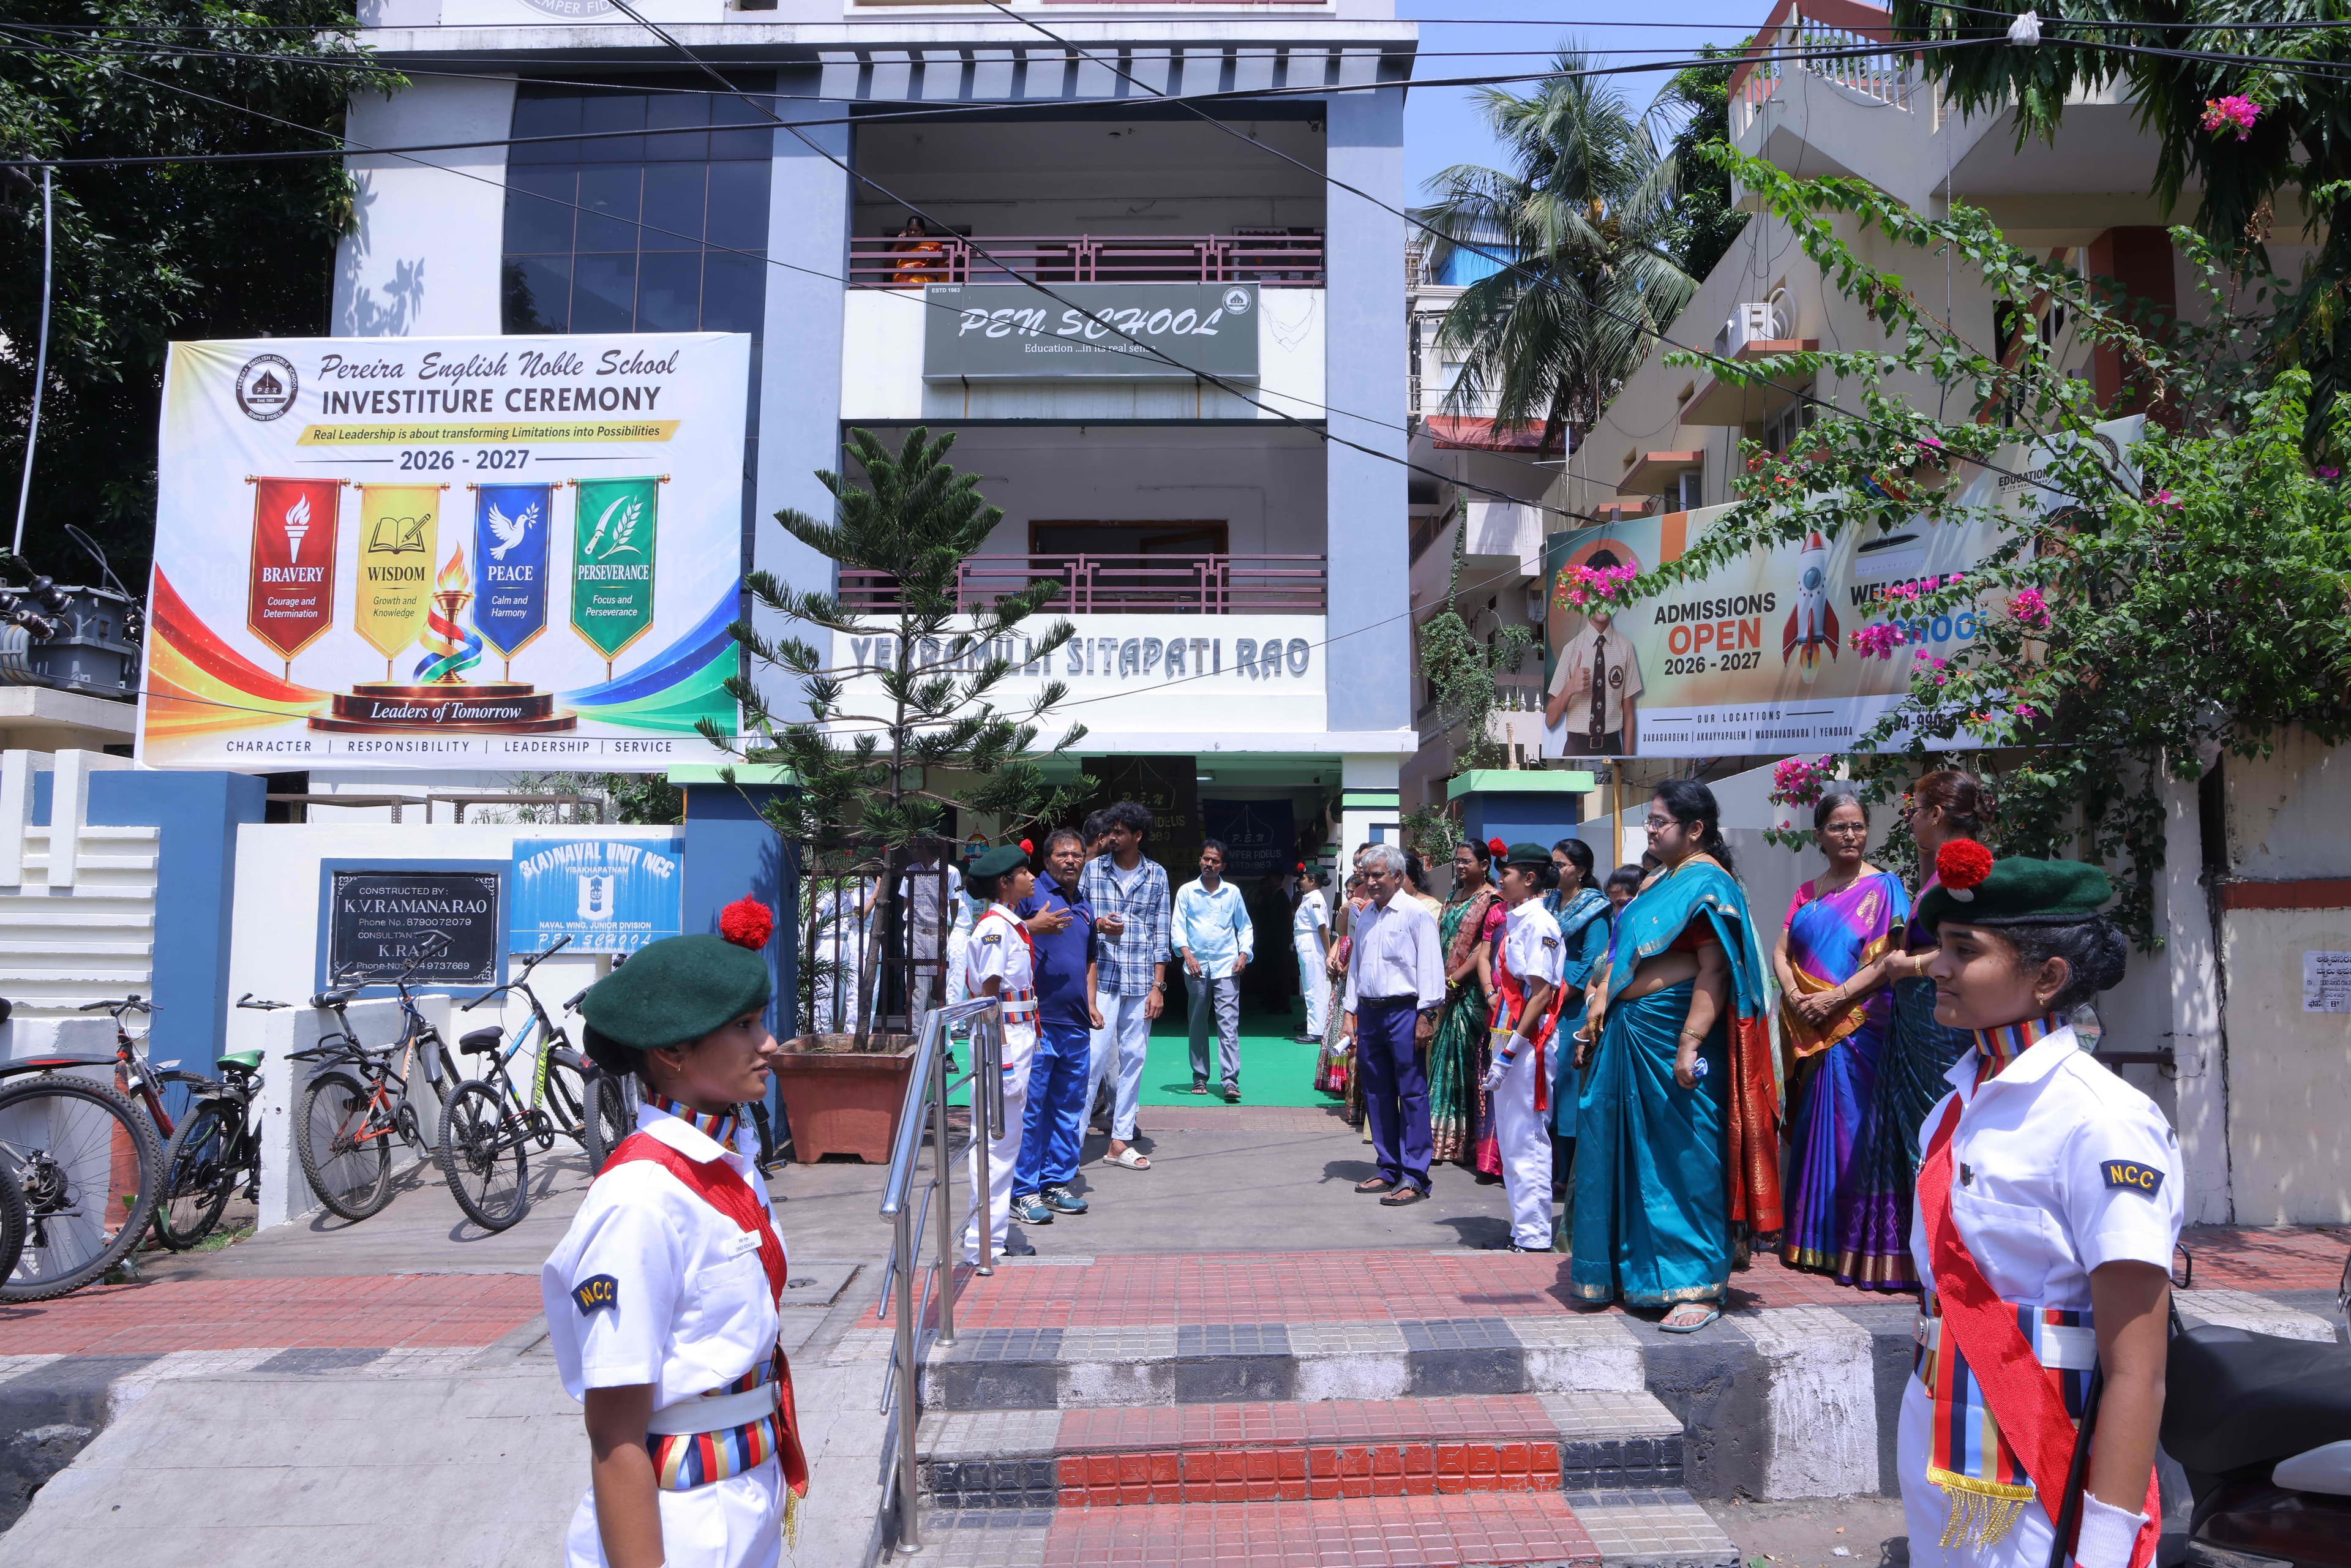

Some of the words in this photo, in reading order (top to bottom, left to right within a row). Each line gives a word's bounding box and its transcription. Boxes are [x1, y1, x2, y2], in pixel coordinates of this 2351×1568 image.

[534, 0, 580, 14] EMPER
[958, 308, 1047, 338] PEN
[1057, 307, 1223, 339] SCHOOL
[1024, 343, 1073, 353] Education
[1094, 344, 1106, 353] its
[1108, 344, 1127, 353] real
[247, 355, 271, 368] ENGLISH
[272, 356, 289, 368] NOBLE
[288, 367, 297, 391] SCHOOL
[318, 354, 406, 381] Pereira
[418, 352, 508, 386] English
[518, 350, 584, 378] Noble
[596, 349, 680, 375] School
[323, 389, 493, 415] INVESTITURE
[505, 386, 661, 413] CEREMONY
[313, 429, 336, 440] Real
[339, 429, 396, 441] Leadership
[398, 429, 407, 439] is
[410, 428, 438, 439] about
[442, 427, 509, 440] transforming
[512, 427, 571, 438] Limitations
[573, 426, 594, 437] into
[597, 426, 660, 437] Possibilities
[400, 450, 454, 470] 2026
[476, 449, 530, 470] 2027
[262, 567, 325, 582] BRAVERY
[367, 566, 426, 581] WISDOM
[487, 565, 533, 581] PEACE
[577, 565, 650, 580] PERSEVERANCE
[268, 596, 299, 607] Courage
[301, 596, 317, 606] and
[373, 596, 400, 606] Growth
[402, 596, 417, 605] and
[492, 595, 512, 605] Calm
[513, 595, 528, 605] and
[593, 595, 616, 604] Focus
[617, 595, 633, 604] and
[263, 609, 318, 618] Determination
[373, 609, 415, 618] Knowledge
[492, 608, 527, 619] Harmony
[585, 607, 638, 617] Perseverance
[1654, 592, 1776, 625] ADMISSIONS
[1668, 617, 1761, 655] OPEN
[1067, 637, 1221, 677] SITAPATI
[1235, 638, 1310, 678] RAO
[1664, 656, 1706, 675] 2026
[1720, 651, 1761, 672] 2027
[370, 702, 429, 719] Leaders
[432, 702, 448, 723] of
[451, 702, 522, 719] Tomorrow
[1697, 714, 1715, 723] OUR
[1722, 711, 1781, 722] LOCATIONS
[1643, 733, 1689, 743] DABAGARDENS
[1697, 730, 1746, 741] AKKAYYAPALEM
[1755, 727, 1810, 740] MADHAVADHARA
[1820, 726, 1853, 737] YENDADA
[227, 741, 312, 752] CHARACTER
[348, 741, 470, 752] RESPONSIBILITY
[504, 741, 590, 752] LEADERSHIP
[615, 741, 672, 752] SERVICE
[1155, 815, 1186, 828] IDELIS
[606, 842, 642, 865] UNIT
[642, 851, 675, 878] NCC
[1228, 850, 1253, 860] MPER
[583, 933, 652, 946] SCHOOL
[1543, 938, 1556, 947] NCC
[378, 945, 448, 958] K.RAU
[534, 1046, 547, 1109] HERCULES
[2110, 1164, 2154, 1188] NCC
[579, 1281, 613, 1308] NCC
